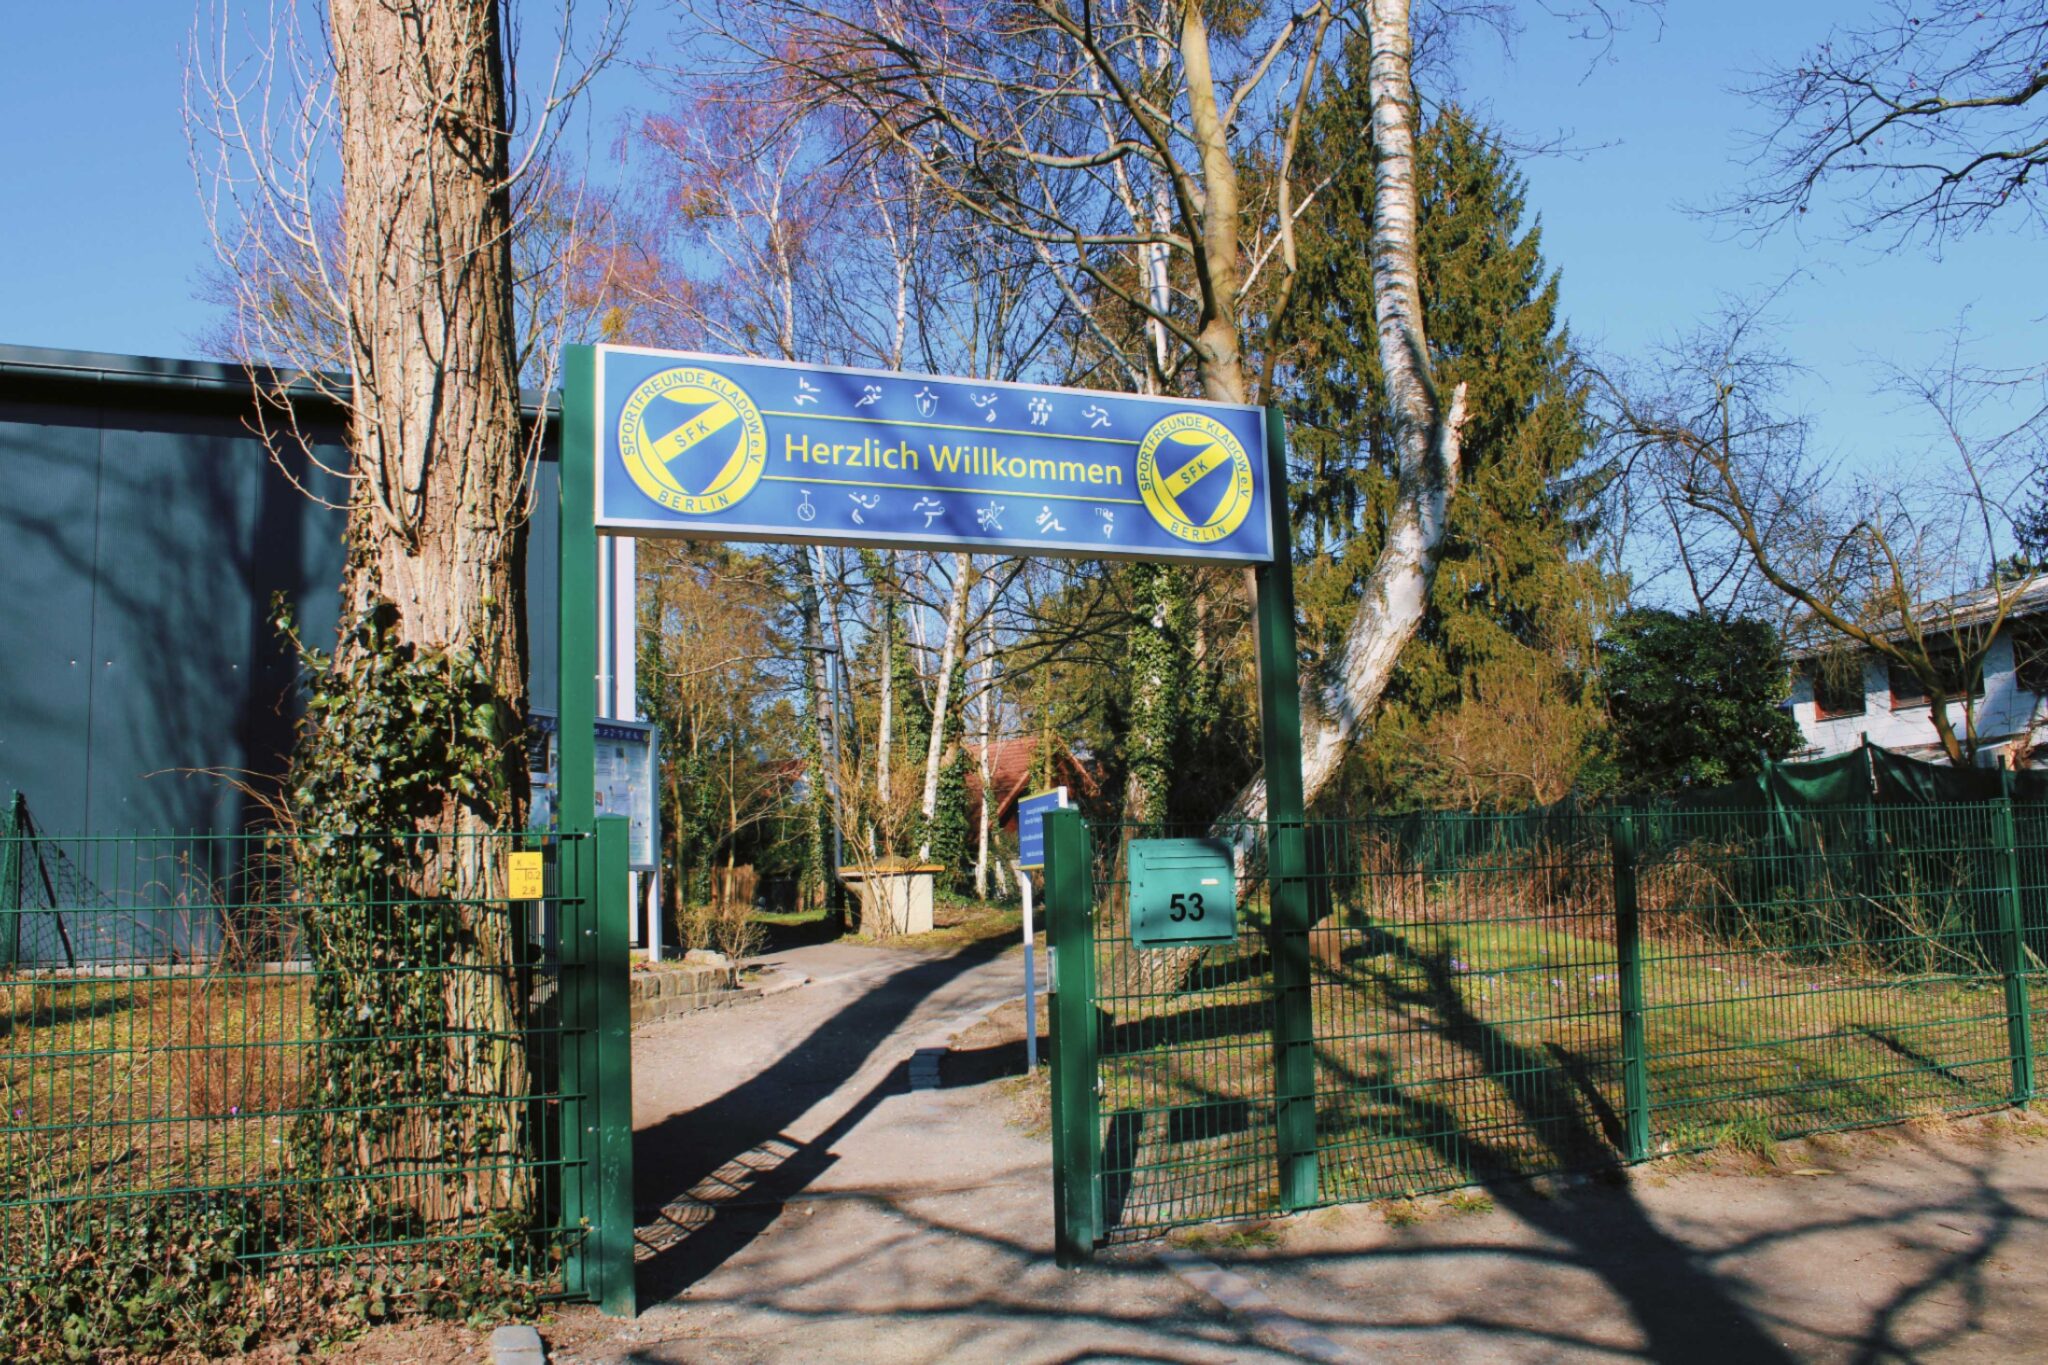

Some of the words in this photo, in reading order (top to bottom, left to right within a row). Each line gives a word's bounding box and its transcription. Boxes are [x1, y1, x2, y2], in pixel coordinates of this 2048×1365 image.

[621, 370, 706, 457] SPORTFREUNDE
[710, 376, 762, 436] KLADOW
[674, 419, 711, 449] SFK
[784, 432, 919, 471] Herzlich
[928, 443, 1123, 486] Willkommen
[1138, 415, 1203, 492] SPORTFREUNDE
[1206, 421, 1249, 473] KLADOW
[1179, 458, 1209, 485] SFK
[658, 489, 730, 512] BERLIN
[1170, 521, 1227, 541] BERLIN
[1169, 892, 1205, 922] 53
